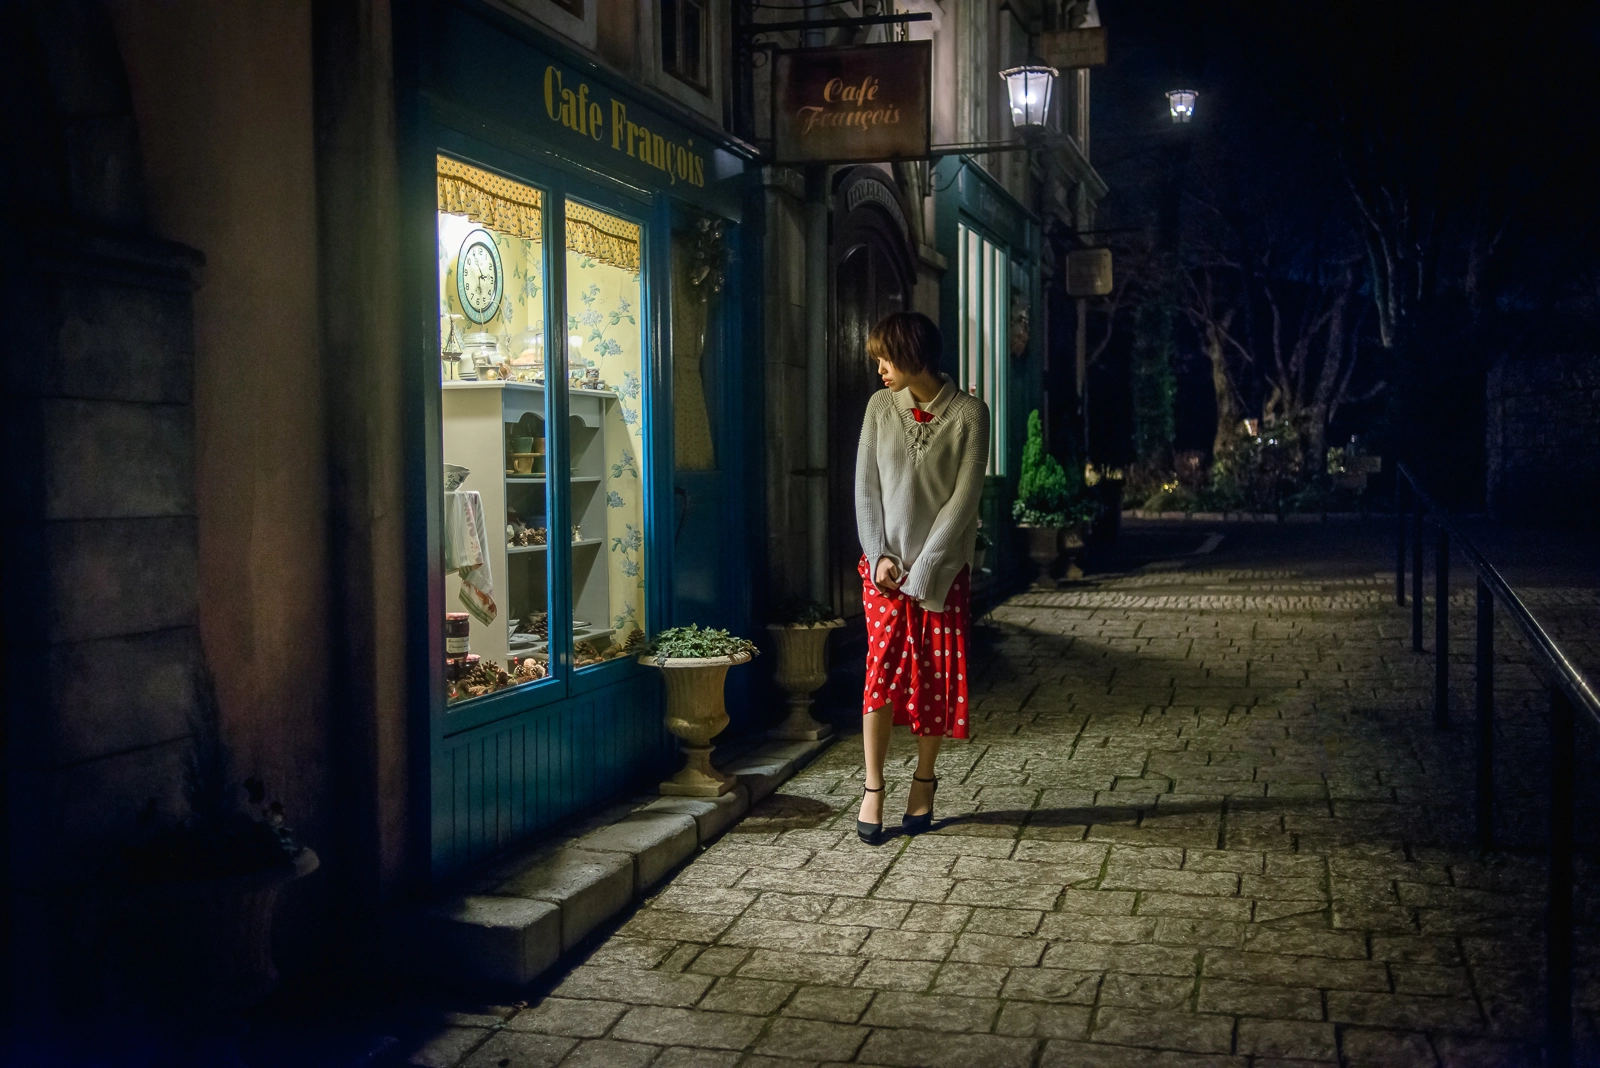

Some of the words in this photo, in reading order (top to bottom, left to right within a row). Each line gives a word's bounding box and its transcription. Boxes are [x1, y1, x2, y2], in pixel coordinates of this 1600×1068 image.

[823, 75, 880, 107] Café
[796, 103, 900, 136] François
[543, 65, 603, 141] Cafe
[610, 98, 705, 188] François
[488, 262, 493, 271] 2
[464, 268, 468, 277] 9
[490, 276, 494, 285] 3
[465, 282, 470, 290] 8
[470, 292, 475, 301] 7
